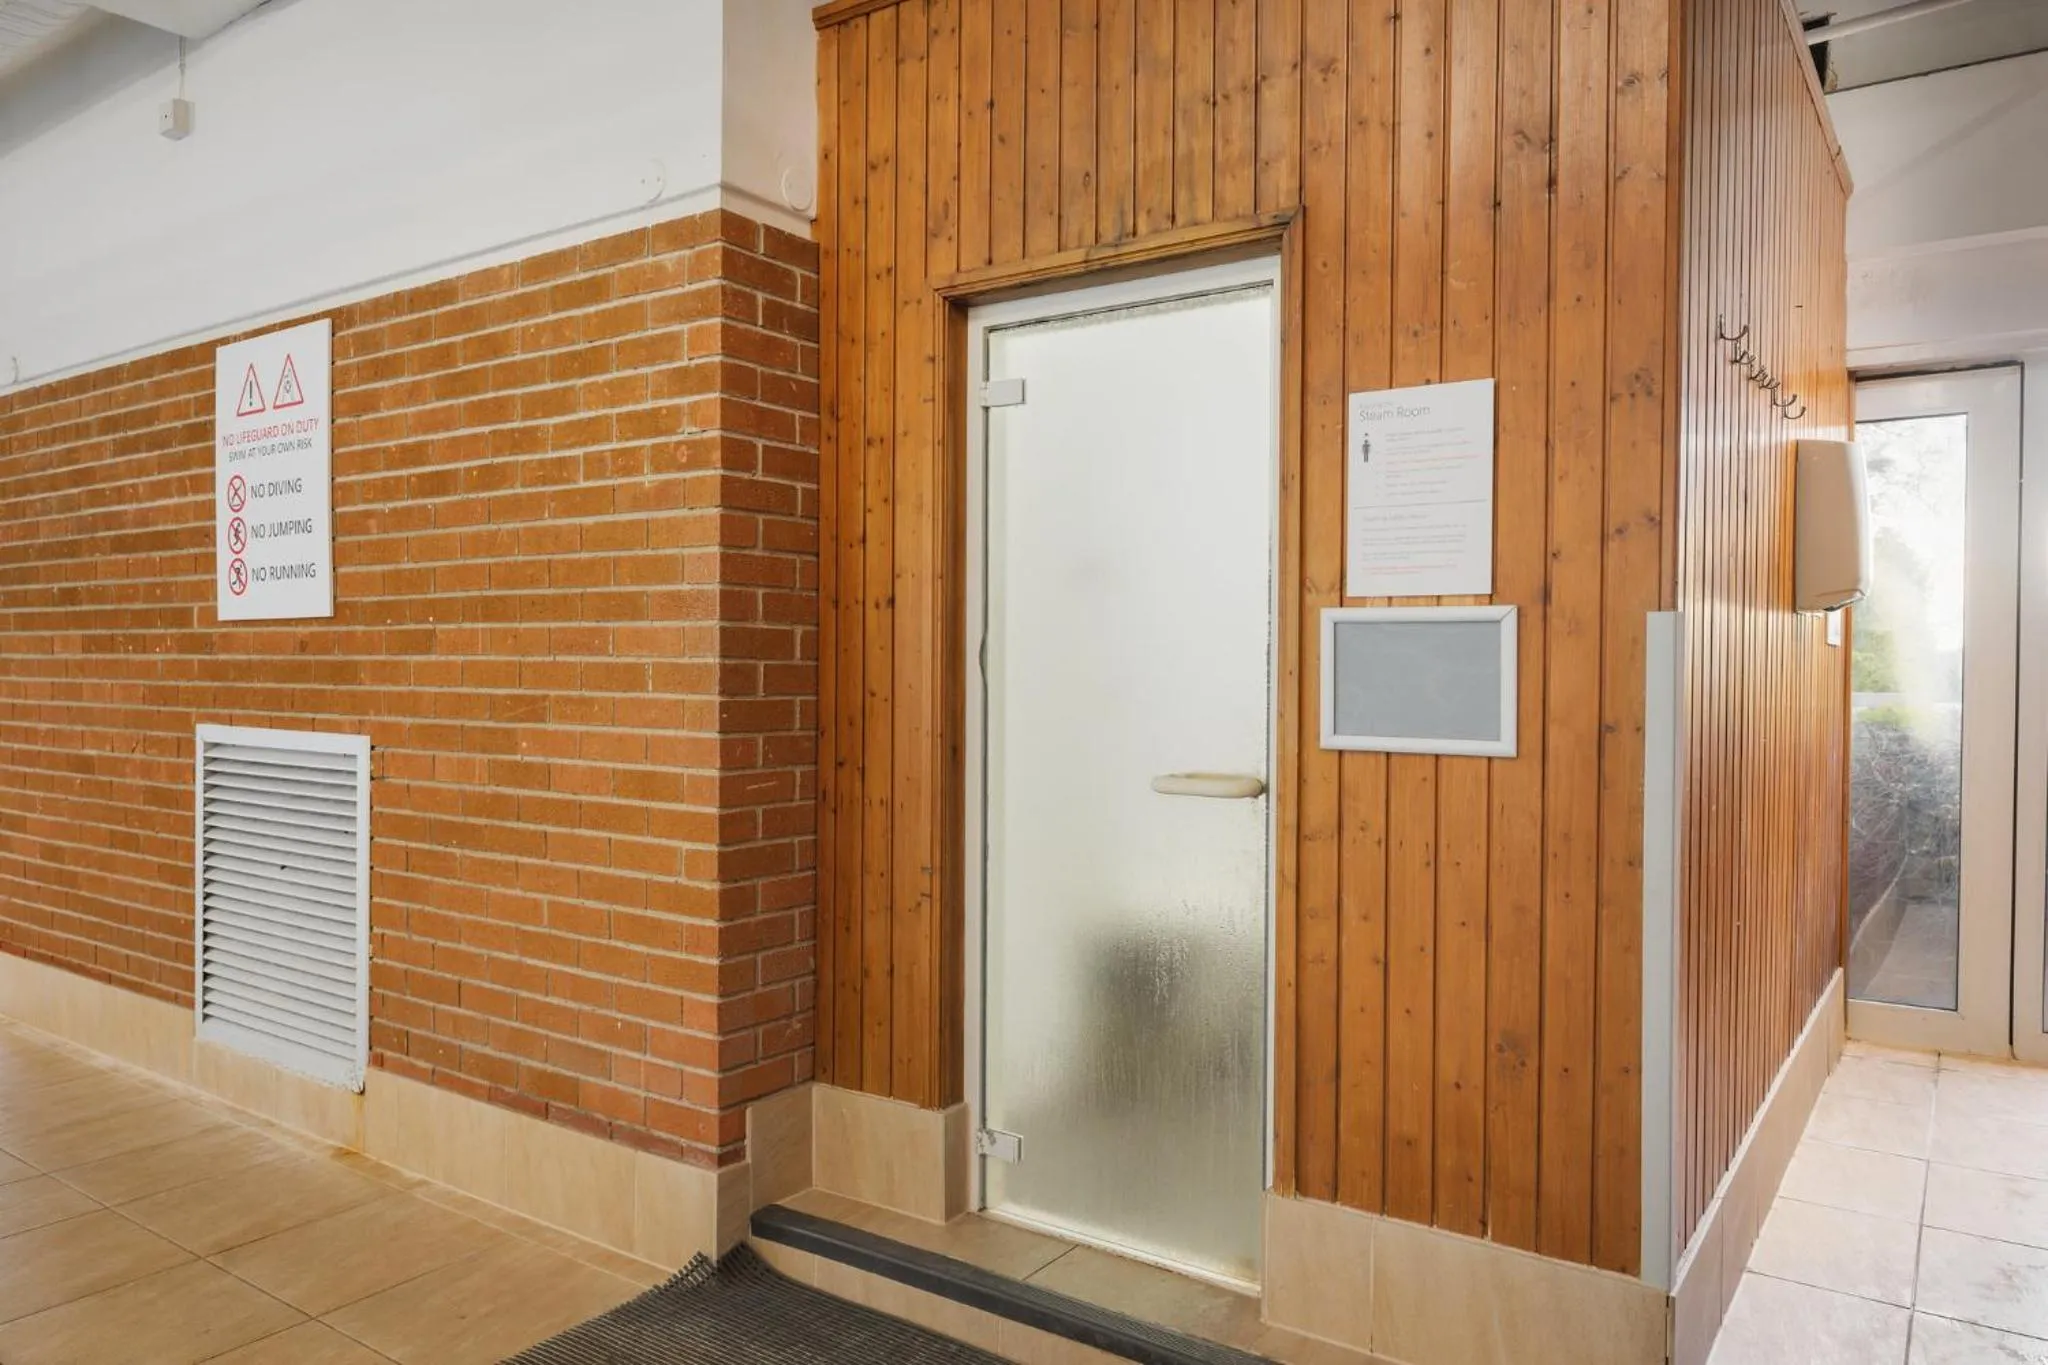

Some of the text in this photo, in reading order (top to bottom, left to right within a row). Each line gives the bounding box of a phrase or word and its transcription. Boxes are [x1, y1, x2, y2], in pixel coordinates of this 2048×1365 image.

[1359, 406, 1431, 422] Steam Room
[222, 418, 319, 447] NO LIFEGUARD ON DUTY
[228, 438, 312, 462] SWIM AT YOUR OWN RISK
[251, 478, 302, 498] NO DIVING
[251, 518, 312, 539] NO JUMPING
[251, 563, 316, 582] NO RUNNING
